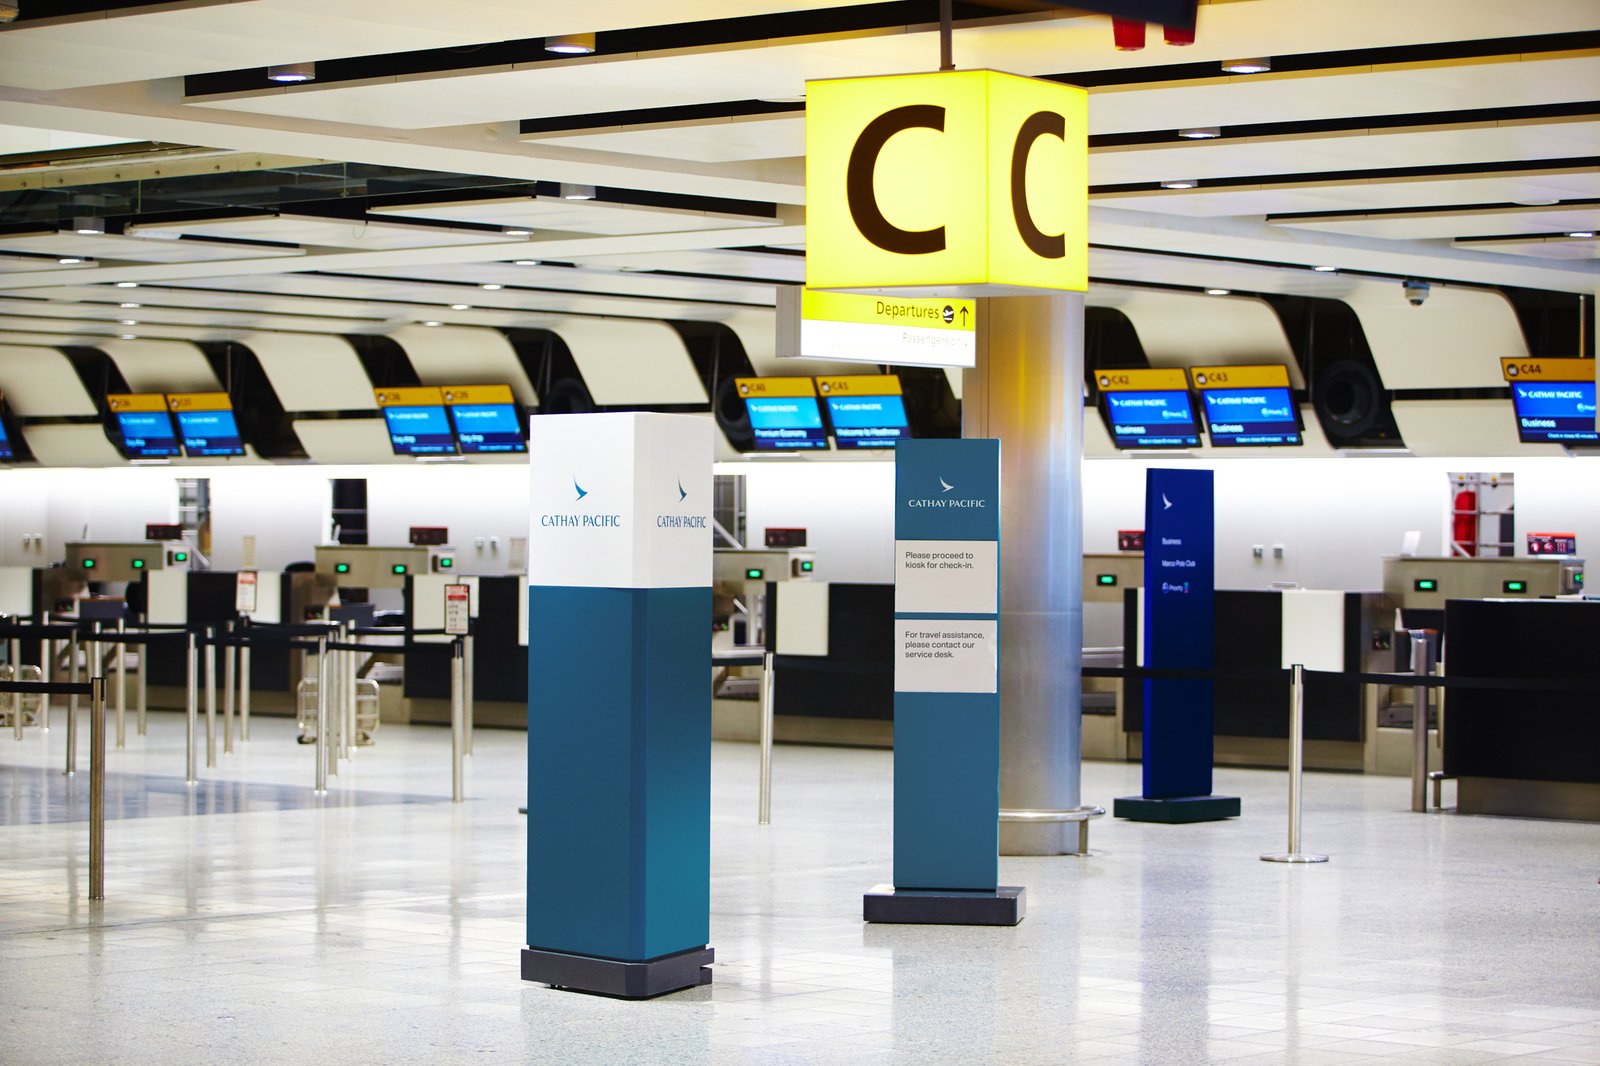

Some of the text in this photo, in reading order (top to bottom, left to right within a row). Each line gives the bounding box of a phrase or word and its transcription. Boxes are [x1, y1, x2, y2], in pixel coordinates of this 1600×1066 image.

[847, 104, 946, 254] C
[1011, 111, 1065, 259] C
[877, 301, 940, 319] Departures
[1521, 364, 1541, 374] C44
[1112, 376, 1129, 385] C42
[1209, 373, 1228, 382] C43
[1528, 391, 1583, 399] CATHAY PACIFIC
[1521, 418, 1556, 428] Business
[1115, 425, 1146, 434] Business
[1211, 424, 1244, 433] Business
[908, 499, 985, 508] CATHAY PACIFIC
[541, 515, 620, 527] CATHAY PACIFIC
[657, 515, 706, 528] CATHAY PACIFIC
[1162, 537, 1181, 545] Business
[905, 551, 930, 559] Please
[932, 552, 964, 560] proceed
[905, 561, 926, 569] kiosk
[927, 561, 937, 569] for
[905, 631, 918, 639] For
[942, 632, 984, 640] assistance,
[905, 641, 930, 649] please
